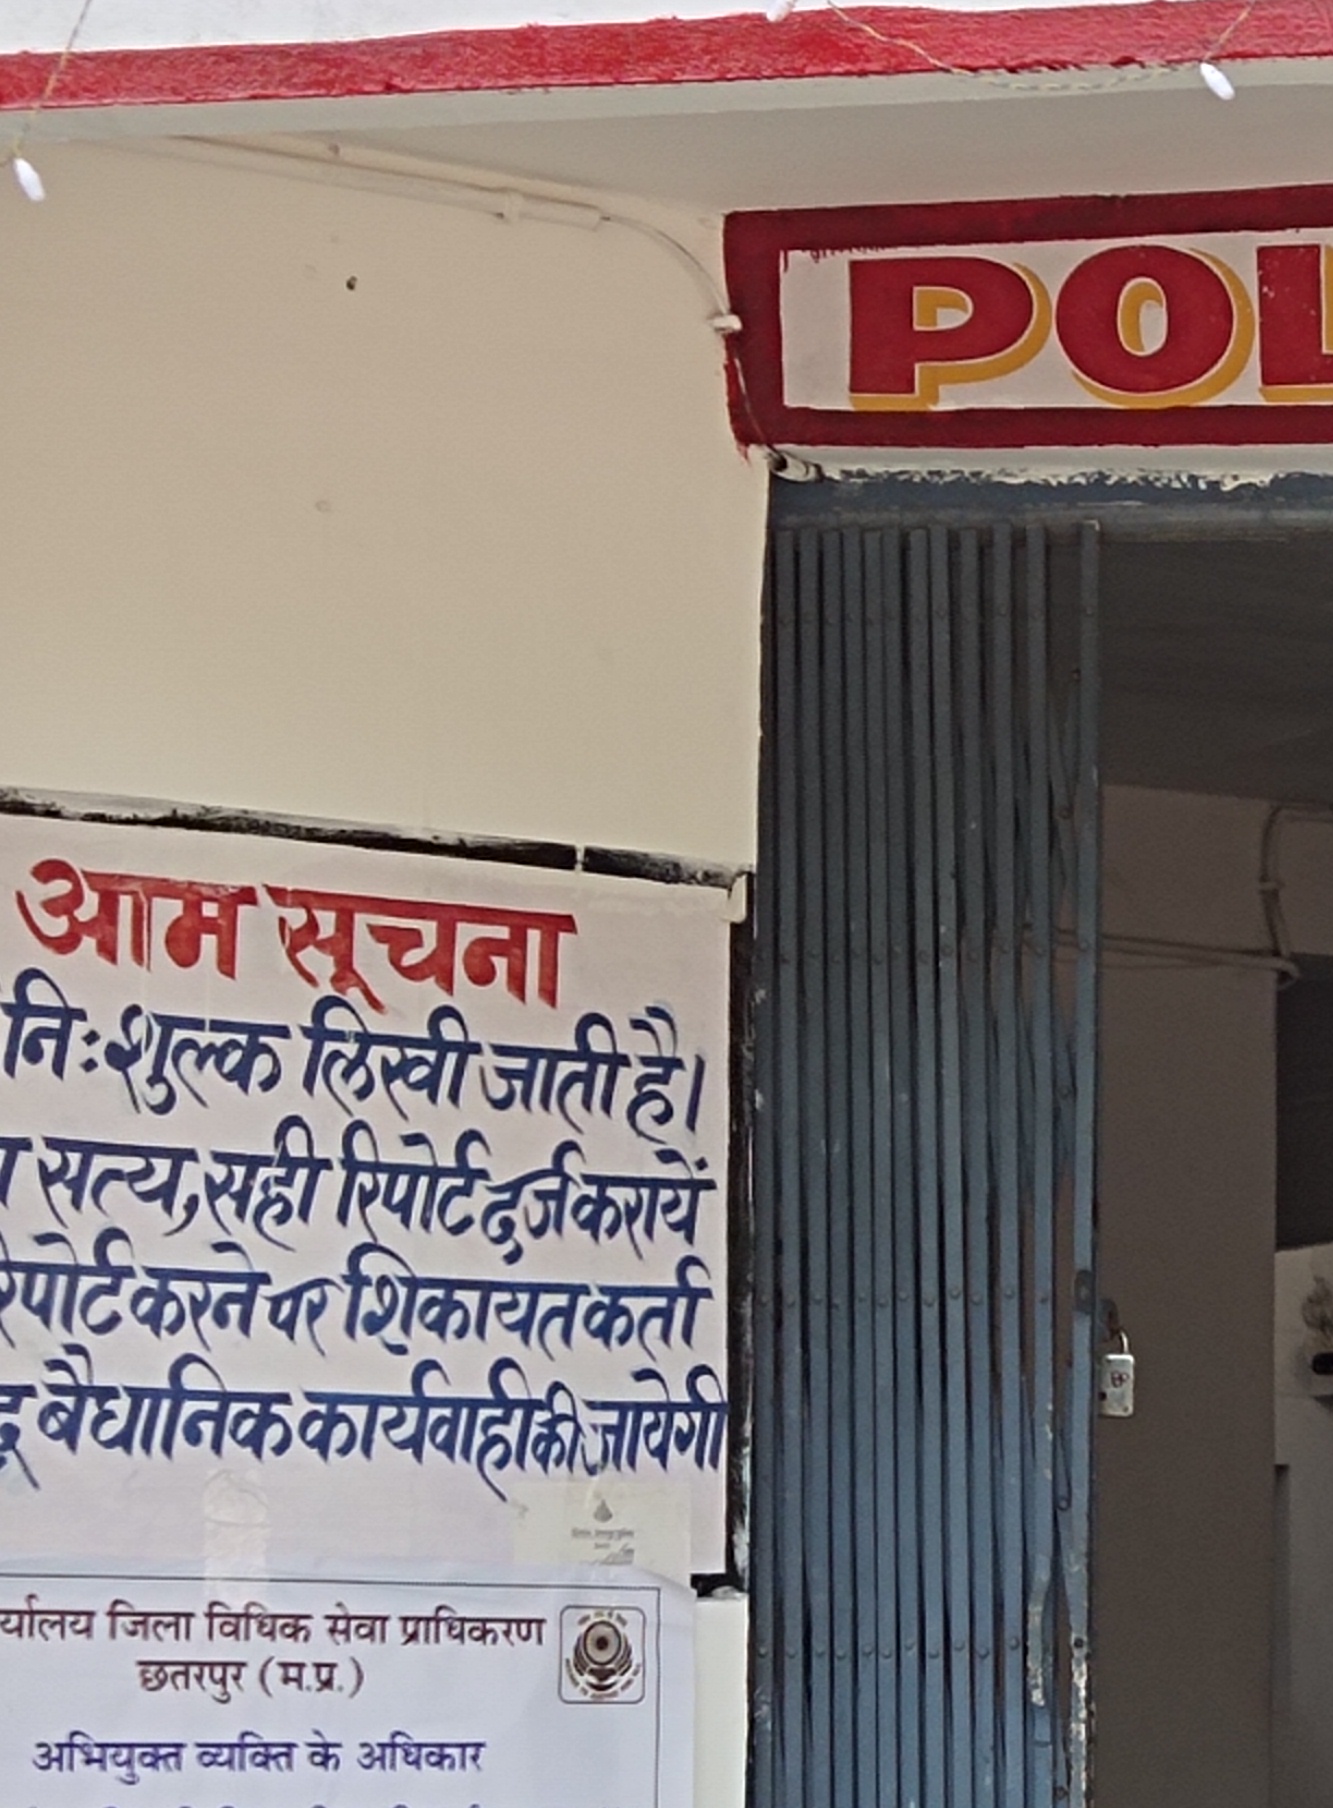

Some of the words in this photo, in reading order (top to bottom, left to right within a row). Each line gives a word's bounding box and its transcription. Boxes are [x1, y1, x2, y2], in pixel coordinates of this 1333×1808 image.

[16, 857, 260, 981] आम
[262, 883, 579, 1014] सूचना
[300, 994, 483, 1121] लिखी
[480, 1012, 632, 1133] जाती
[337, 1119, 493, 1242] रिपोर्ट
[129, 1241, 272, 1351] करने
[263, 1276, 345, 1356] पर
[38, 1343, 294, 1461] बैधानिक
[106, 1599, 196, 1642] जिला
[204, 1600, 314, 1645] विधिक
[323, 1601, 391, 1646] सेवा
[398, 1604, 548, 1647] प्राधिकरण
[136, 1660, 248, 1704] छतरपुर
[33, 1729, 188, 1786] अभियुक्त
[195, 1730, 298, 1774] व्यक्ति
[304, 1728, 343, 1773] के
[356, 1730, 487, 1773] अधिकार
